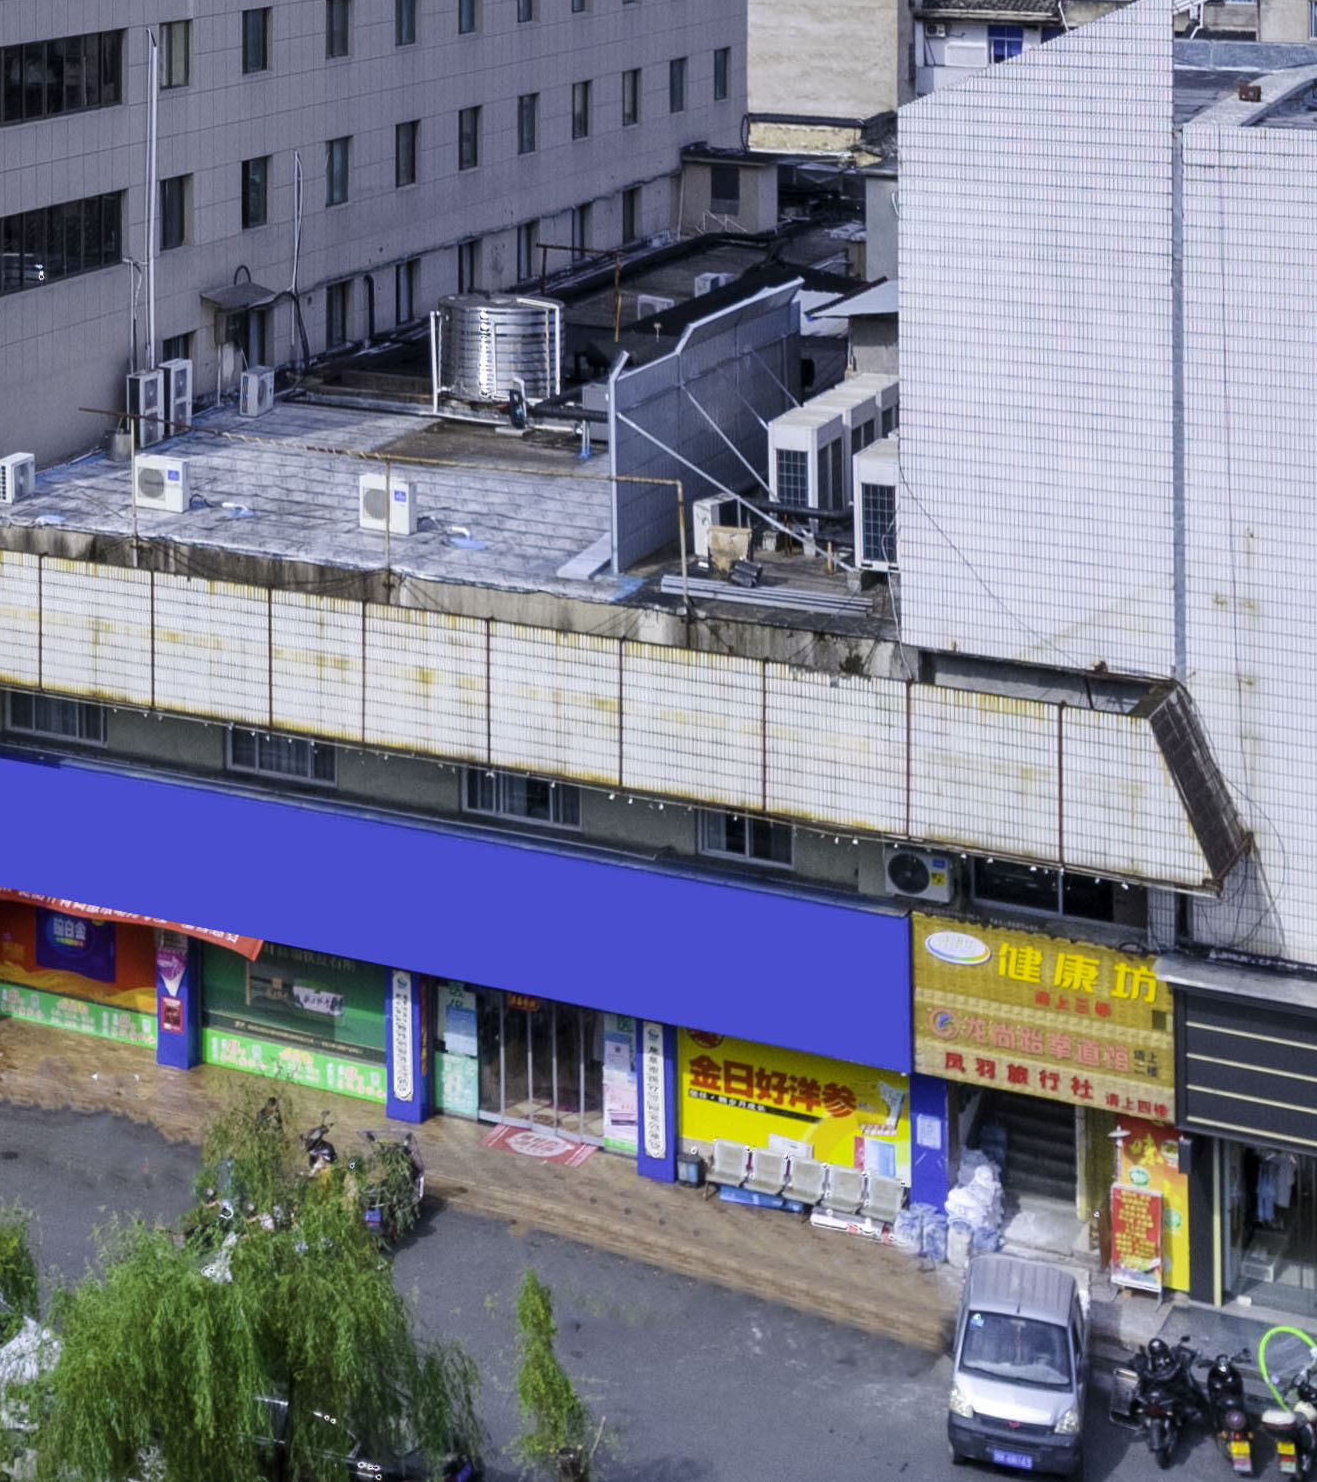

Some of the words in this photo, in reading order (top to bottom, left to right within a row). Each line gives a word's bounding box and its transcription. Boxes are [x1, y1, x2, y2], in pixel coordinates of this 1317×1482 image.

[998, 941, 1158, 1003] 健康坊
[964, 1016, 1130, 1073] 龙尚跆拳道馆
[688, 1054, 858, 1118] 金日好洋参
